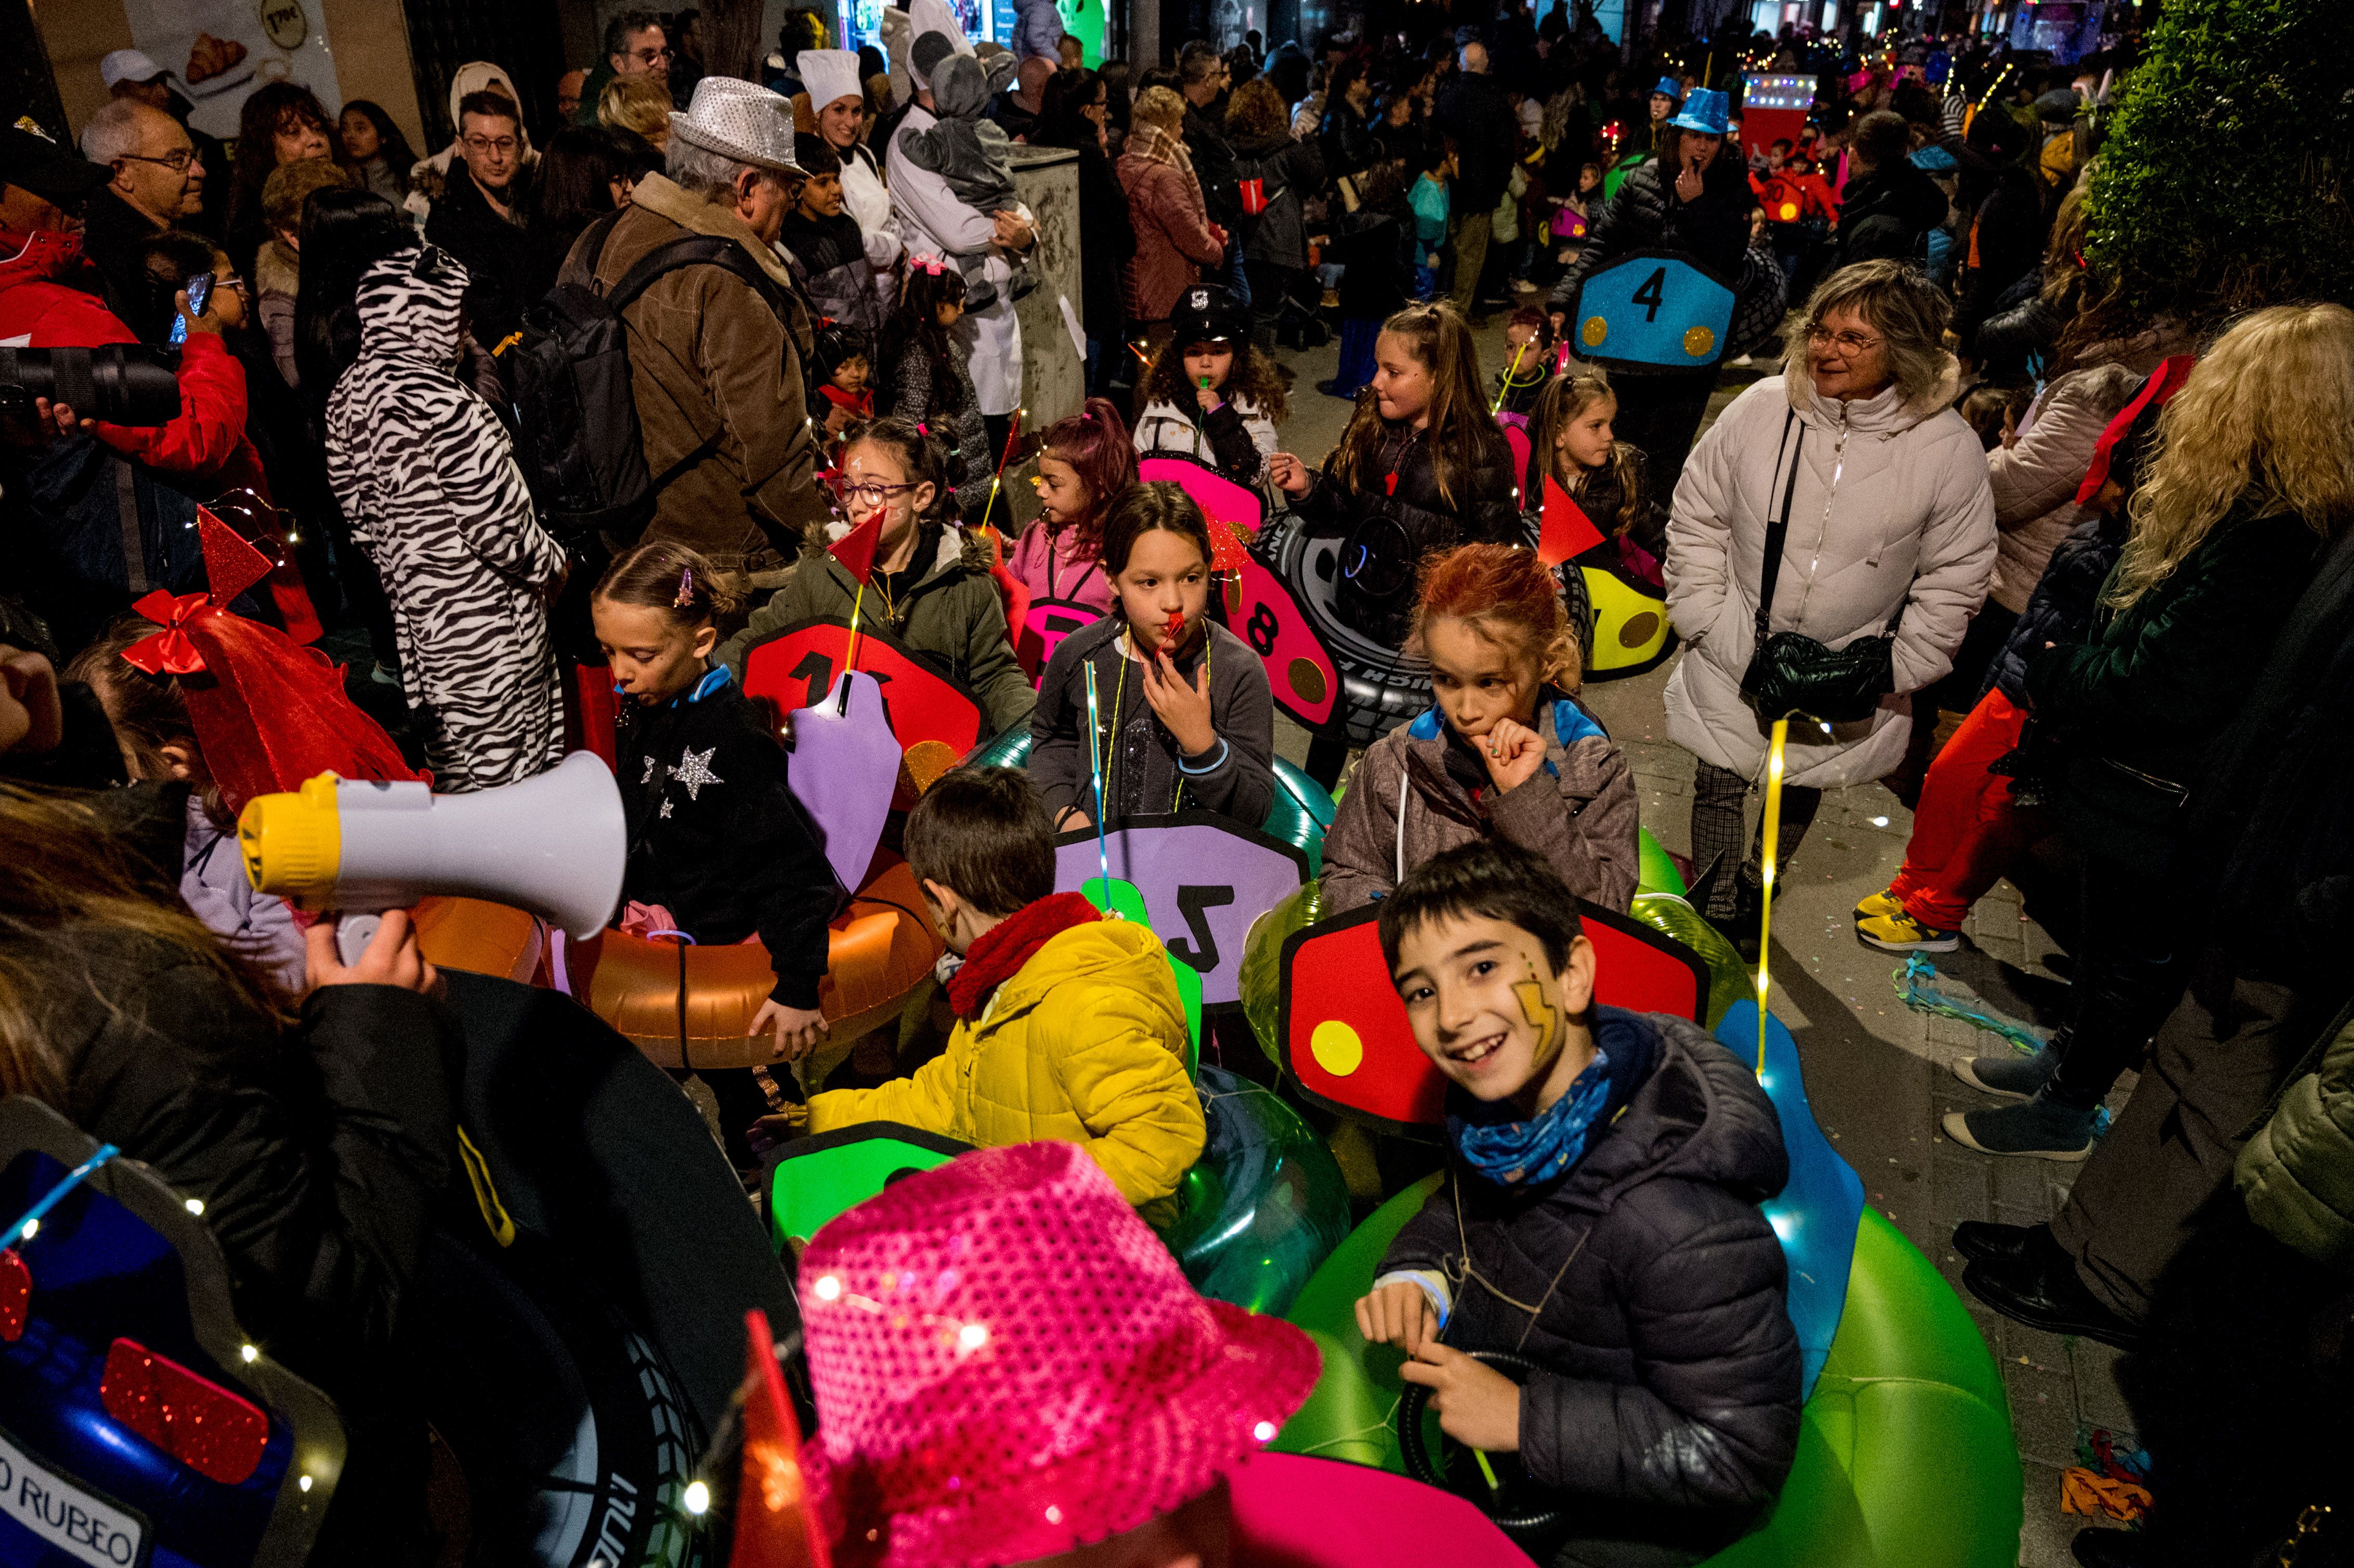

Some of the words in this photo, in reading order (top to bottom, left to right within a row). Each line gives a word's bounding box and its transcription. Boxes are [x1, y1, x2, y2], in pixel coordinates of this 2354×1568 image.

[1631, 266, 1666, 323] 4
[1247, 601, 1279, 657] 8
[19, 1476, 132, 1565] RUBEO
